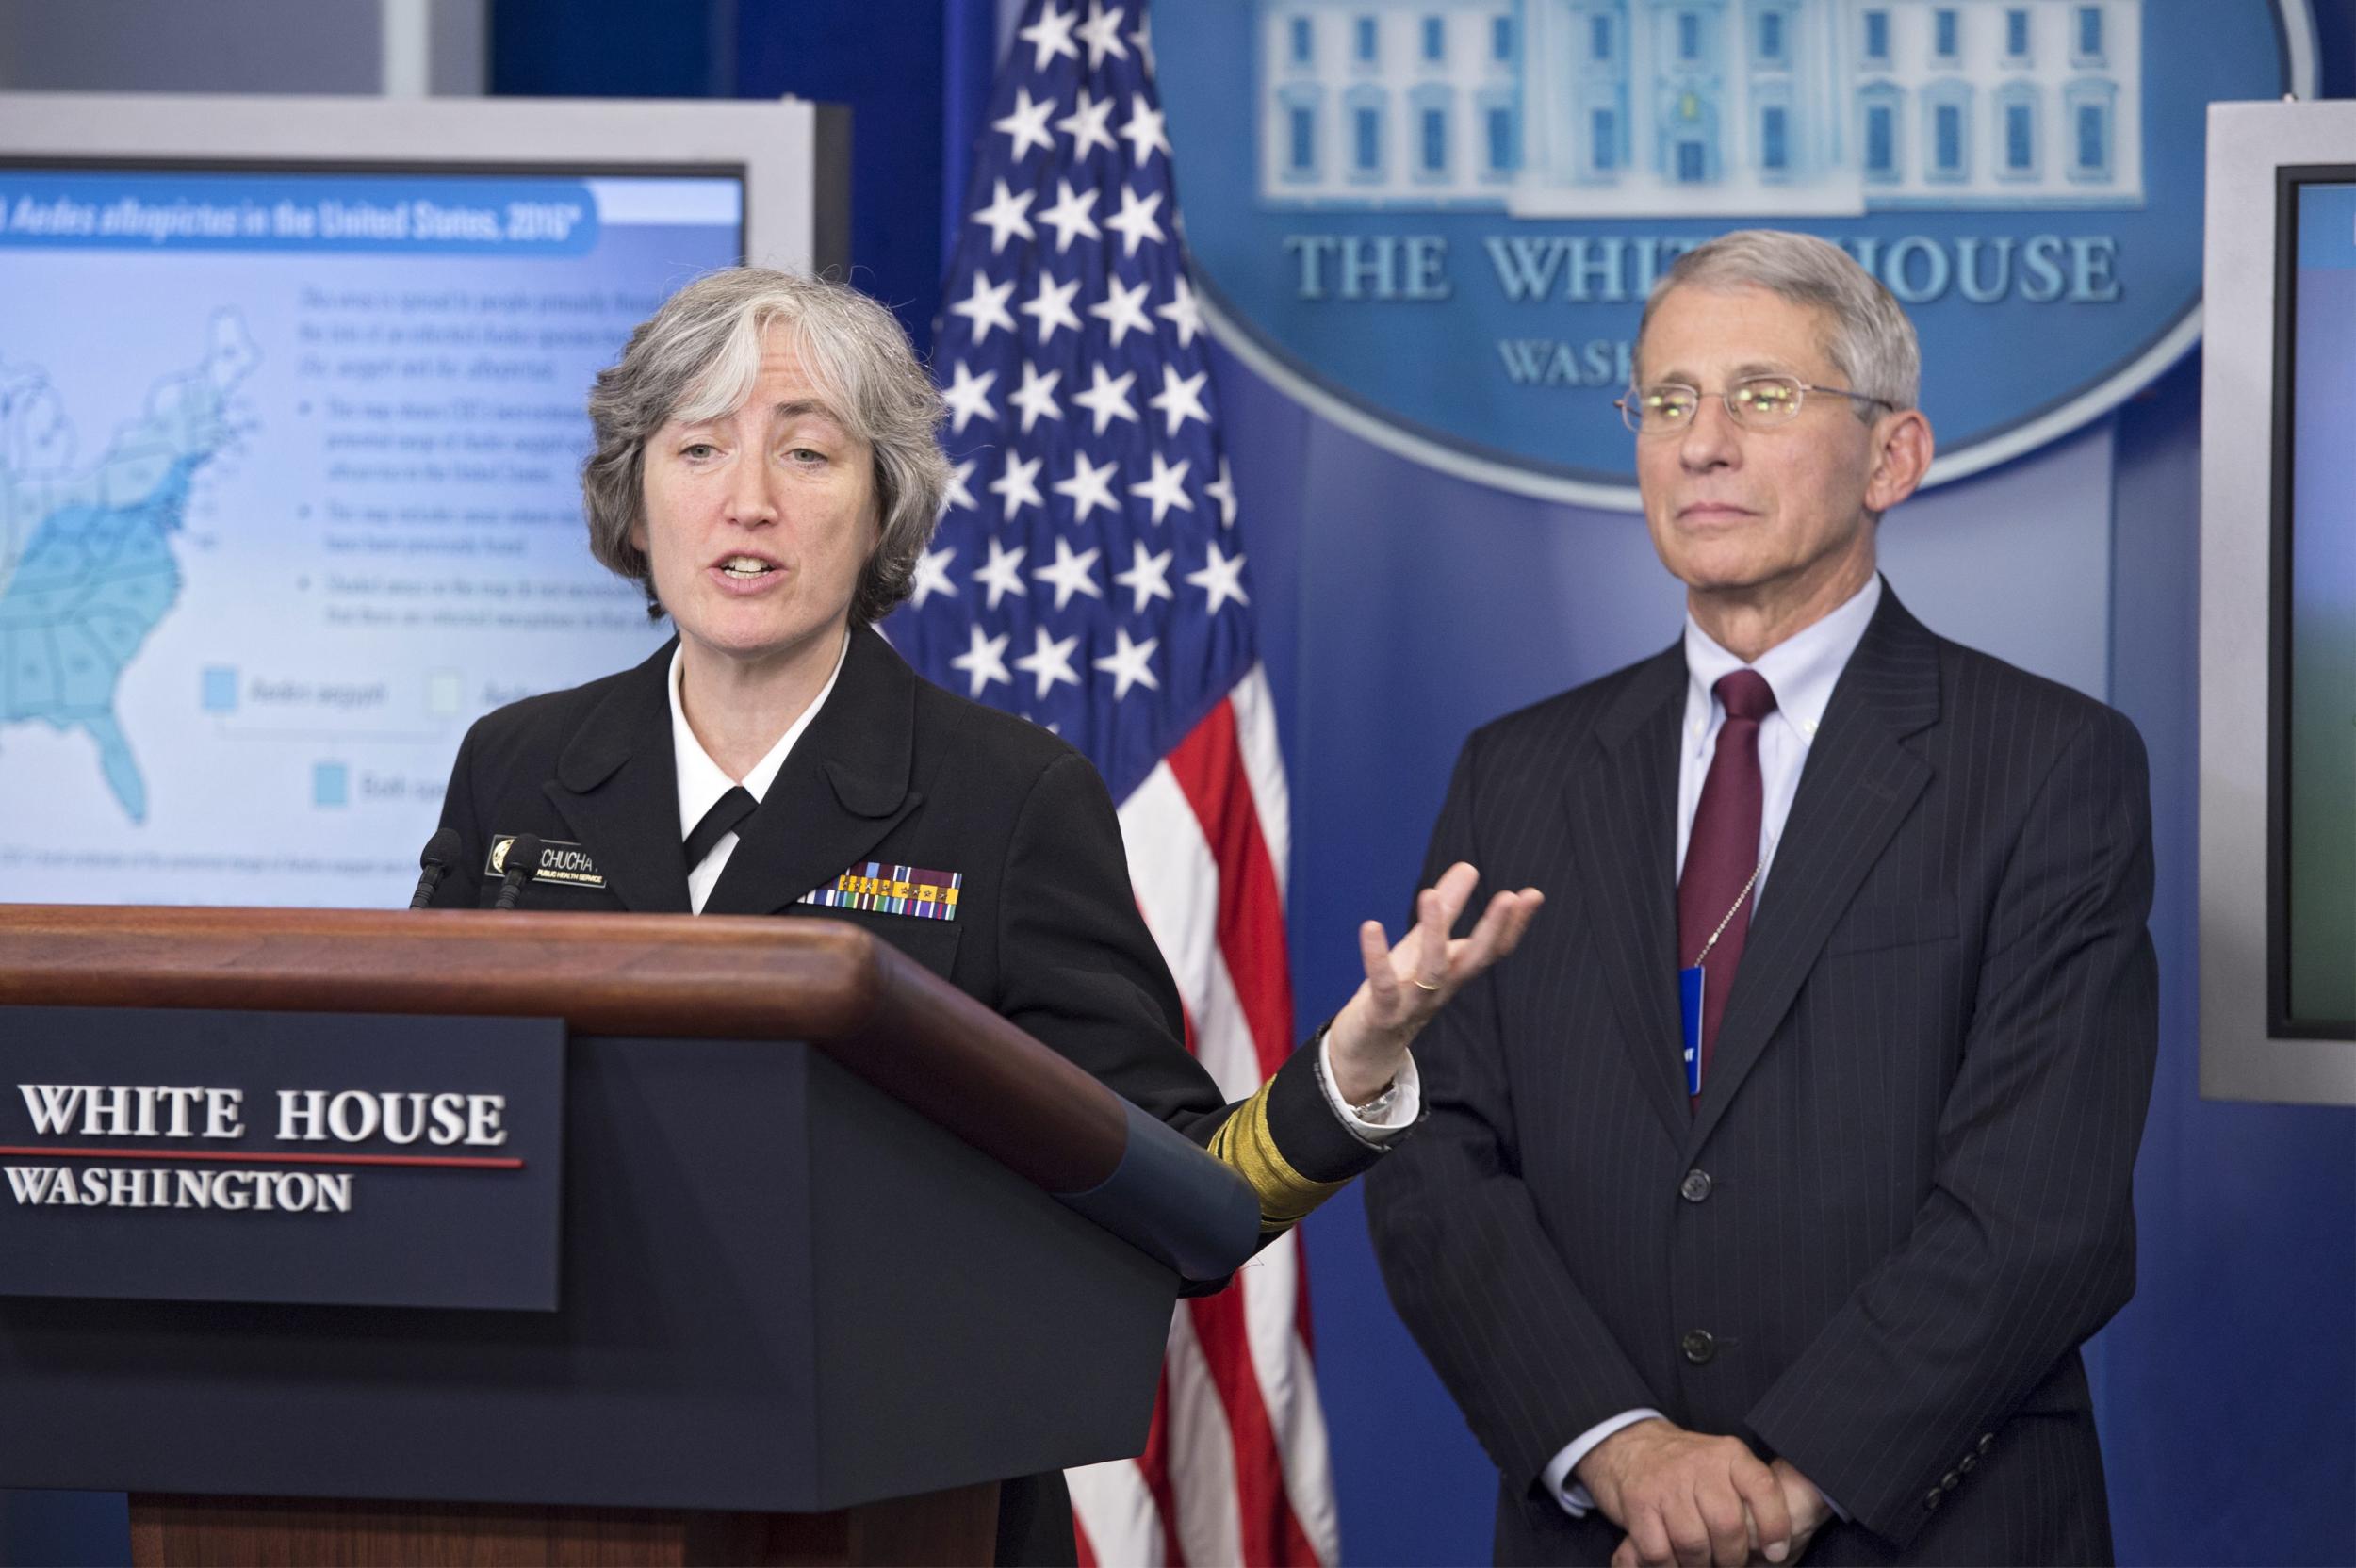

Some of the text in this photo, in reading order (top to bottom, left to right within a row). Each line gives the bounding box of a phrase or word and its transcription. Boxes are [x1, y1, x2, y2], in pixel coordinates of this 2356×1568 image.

[318, 199, 409, 238] United
[1283, 235, 1453, 302] THE
[536, 869, 603, 883] PUBLIC HEALTH SERVICE
[17, 1084, 507, 1145] WHITE HOUSE
[3, 1166, 354, 1212] WASHINGTON
